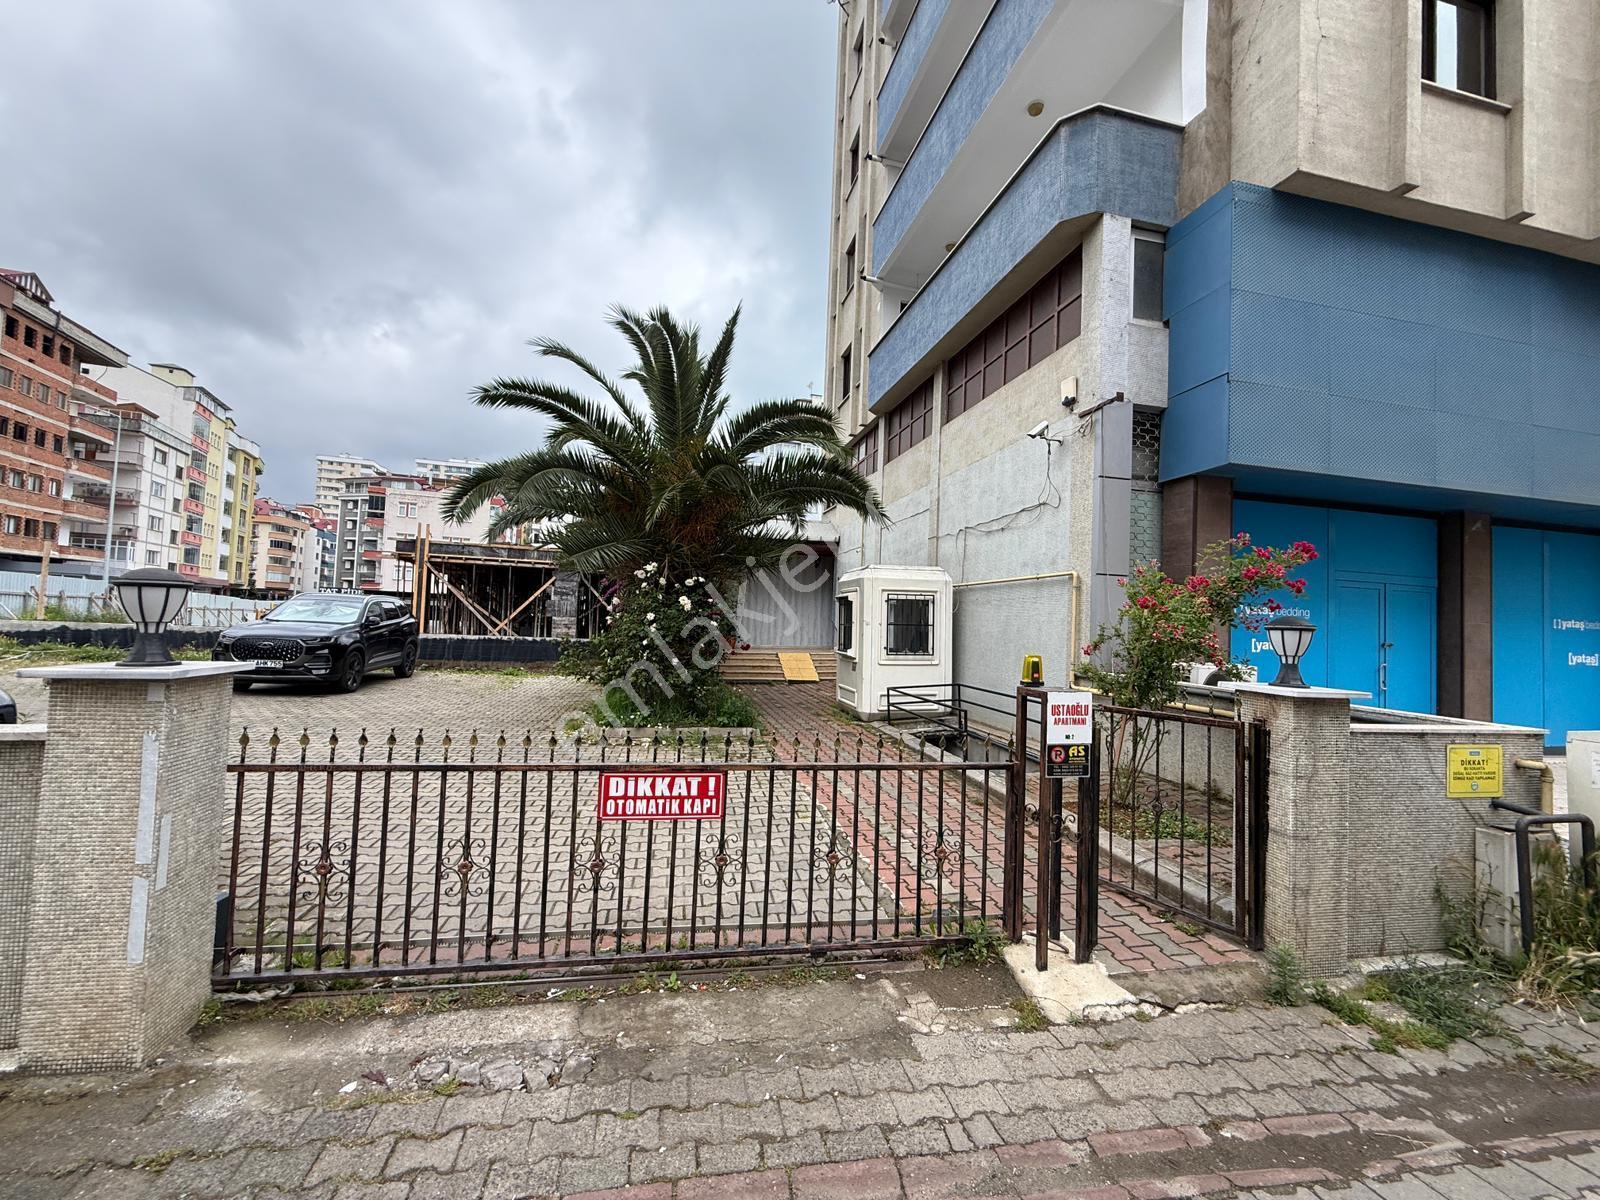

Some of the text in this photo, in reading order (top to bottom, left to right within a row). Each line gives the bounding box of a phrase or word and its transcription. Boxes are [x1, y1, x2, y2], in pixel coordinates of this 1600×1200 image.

[1051, 702, 1089, 717] USTAOĞLU
[1053, 717, 1087, 726] APARTMANI
[1068, 746, 1086, 757] AS
[683, 798, 717, 814] KAPI
